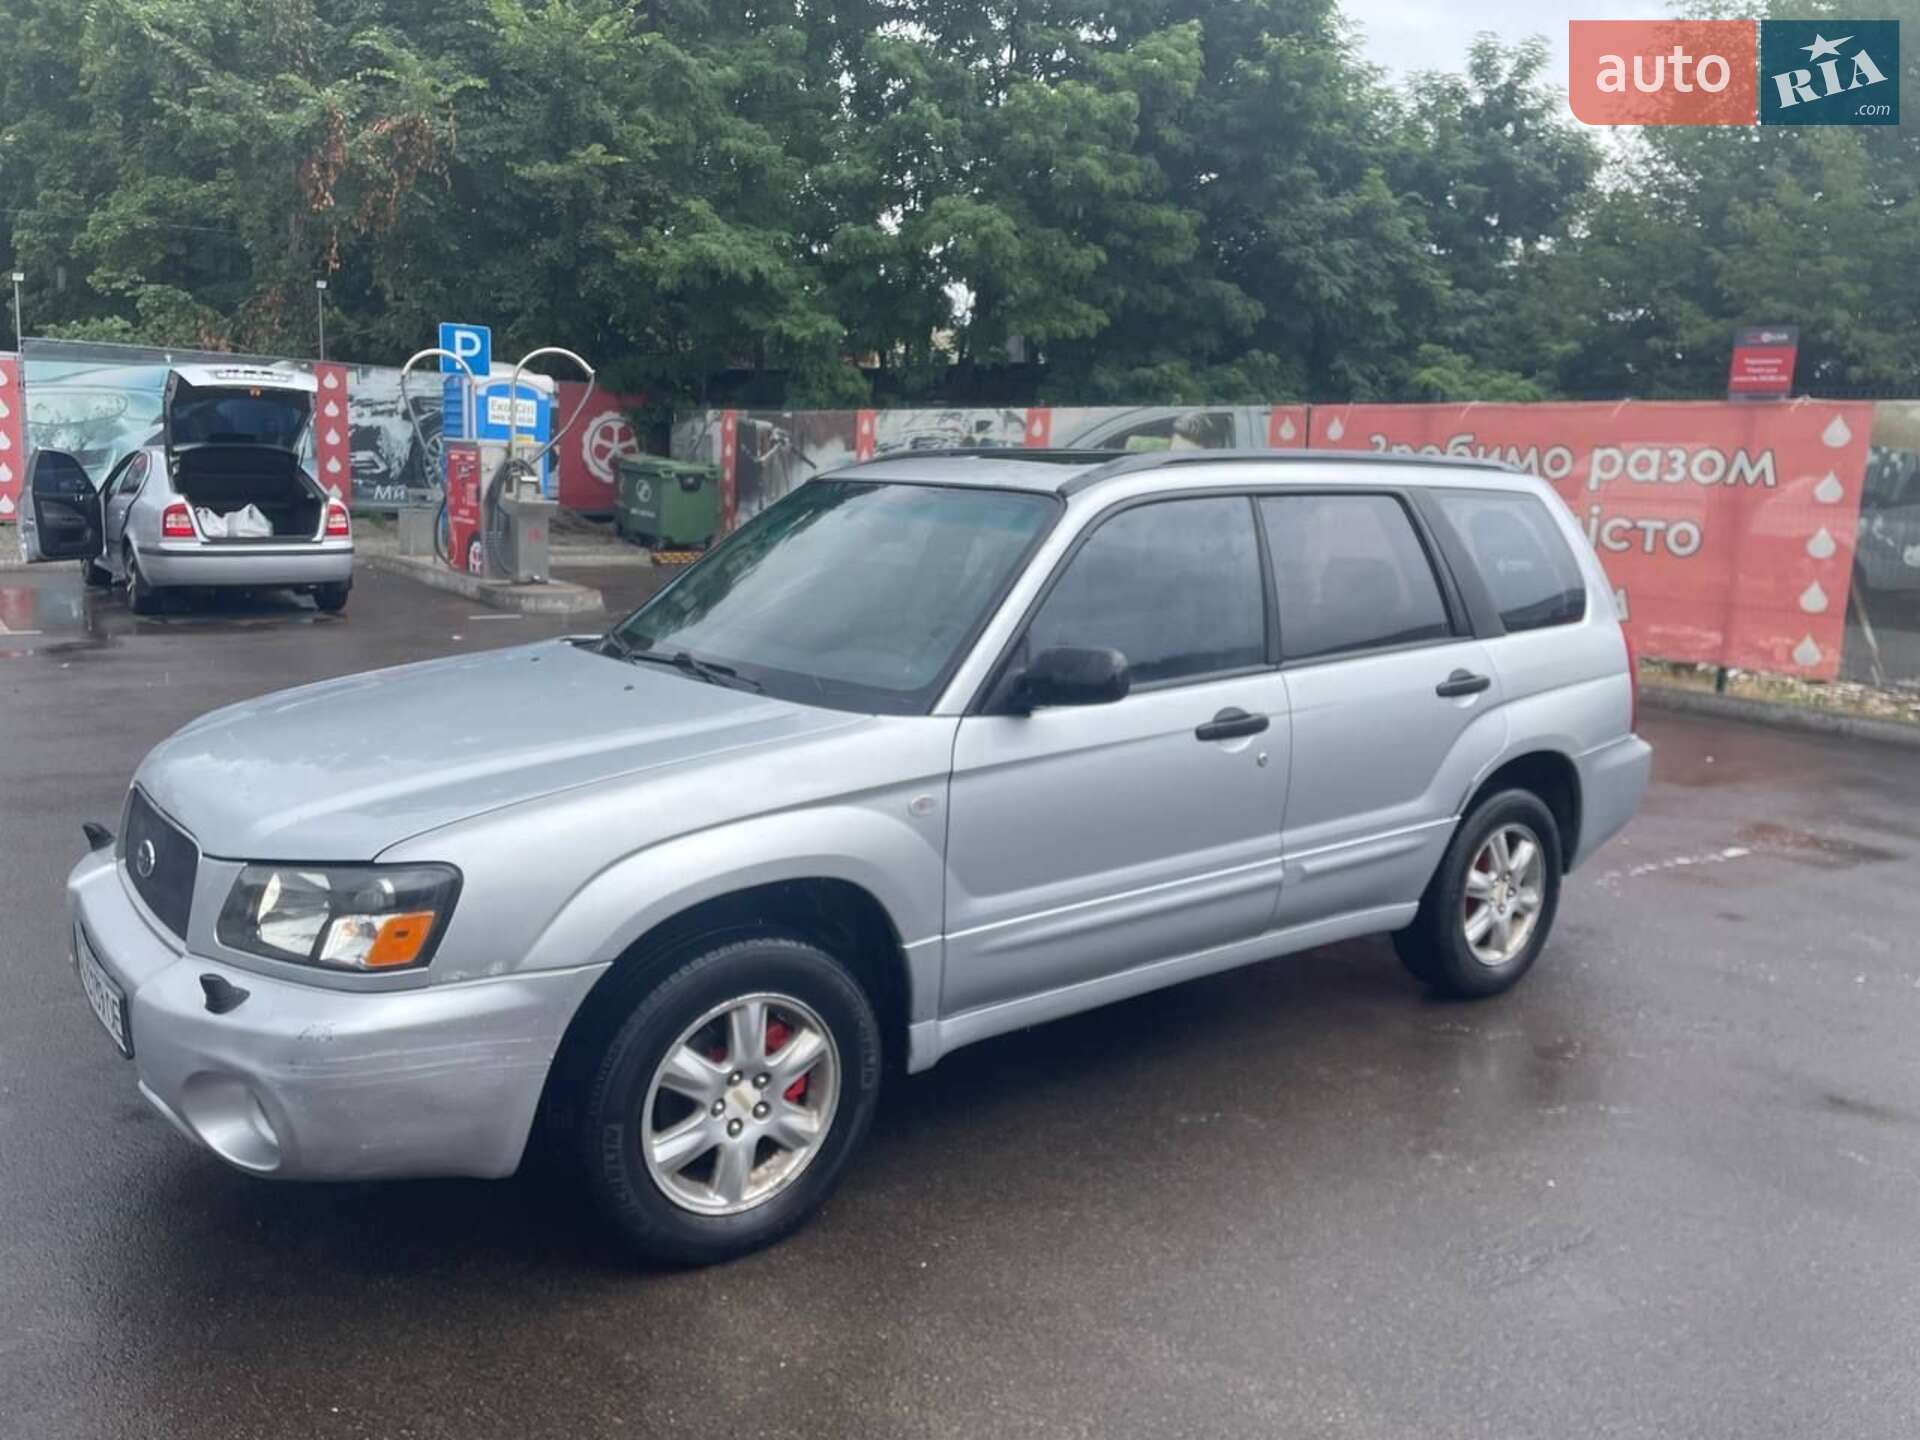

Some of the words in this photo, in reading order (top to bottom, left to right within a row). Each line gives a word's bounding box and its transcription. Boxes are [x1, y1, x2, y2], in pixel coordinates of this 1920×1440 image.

[455, 330, 481, 369] P
[1587, 446, 1777, 490] разом
[1575, 505, 1701, 556] істо
